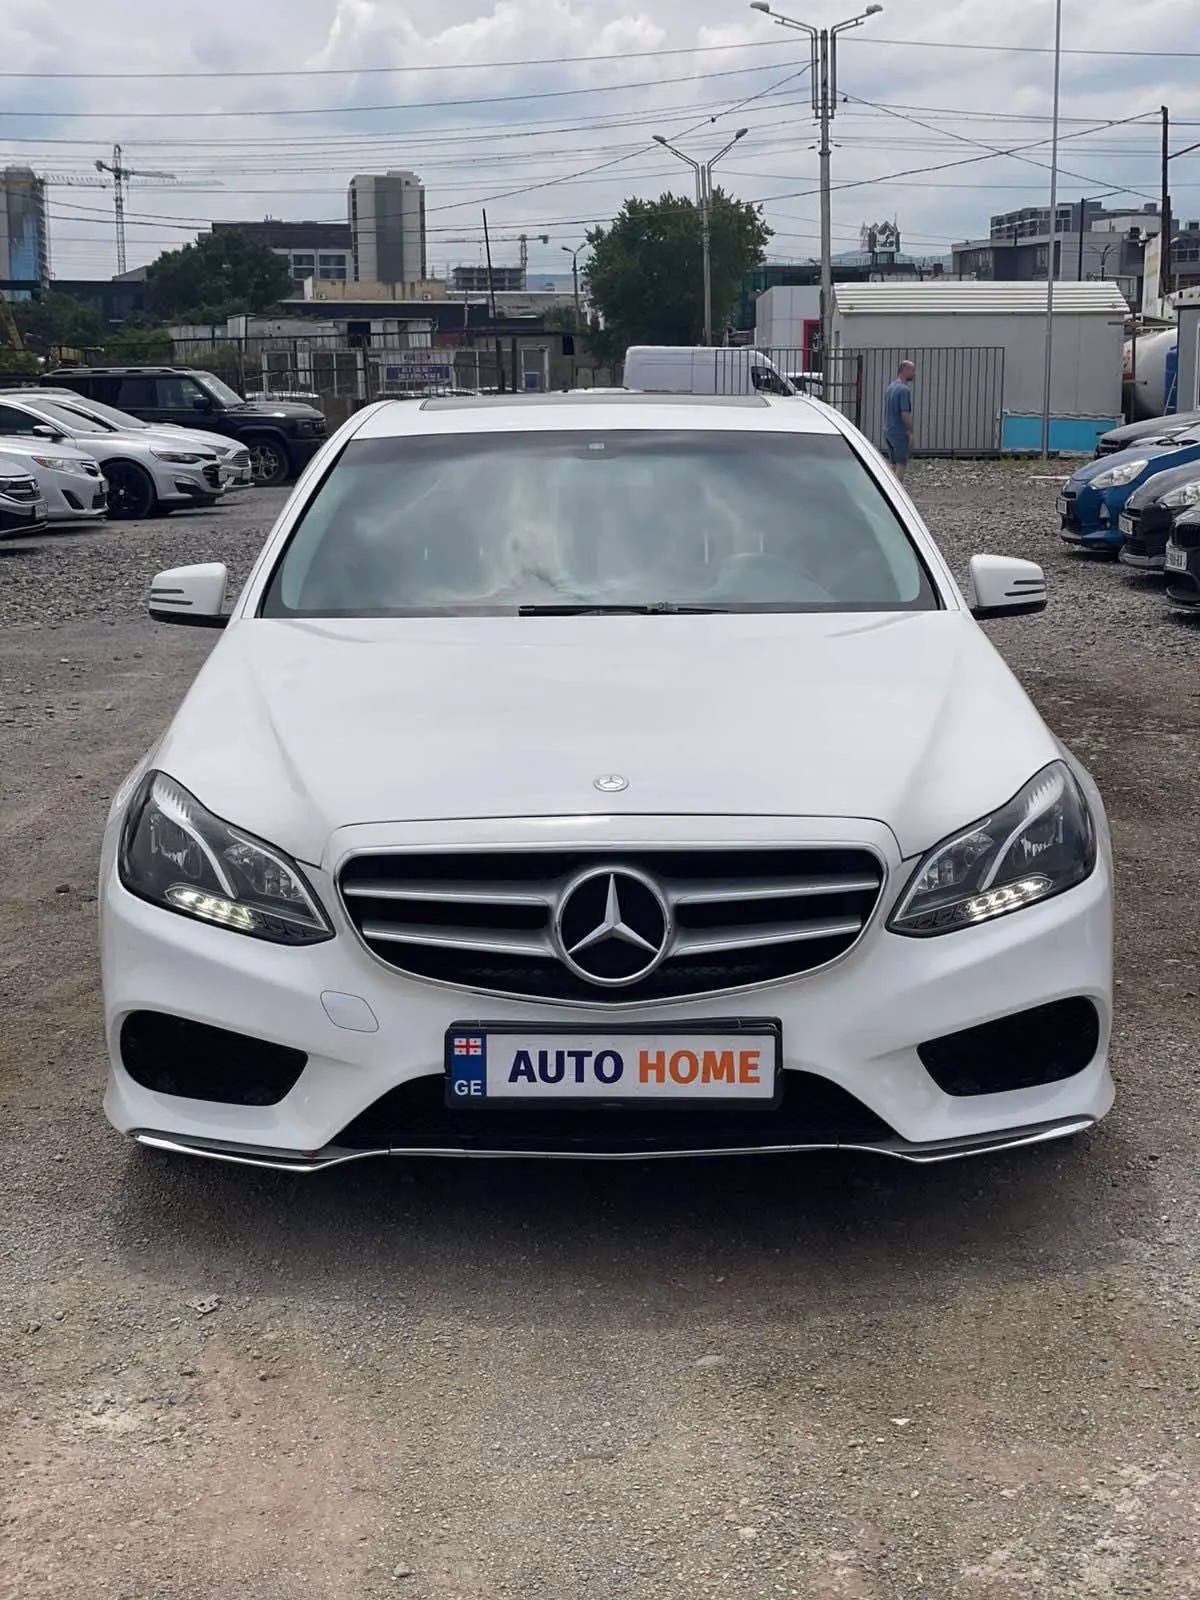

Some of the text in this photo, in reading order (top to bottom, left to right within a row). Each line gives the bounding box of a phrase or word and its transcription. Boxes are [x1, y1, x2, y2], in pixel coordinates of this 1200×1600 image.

[508, 1050, 761, 1084] AUTO HOME
[454, 1079, 482, 1096] GE
